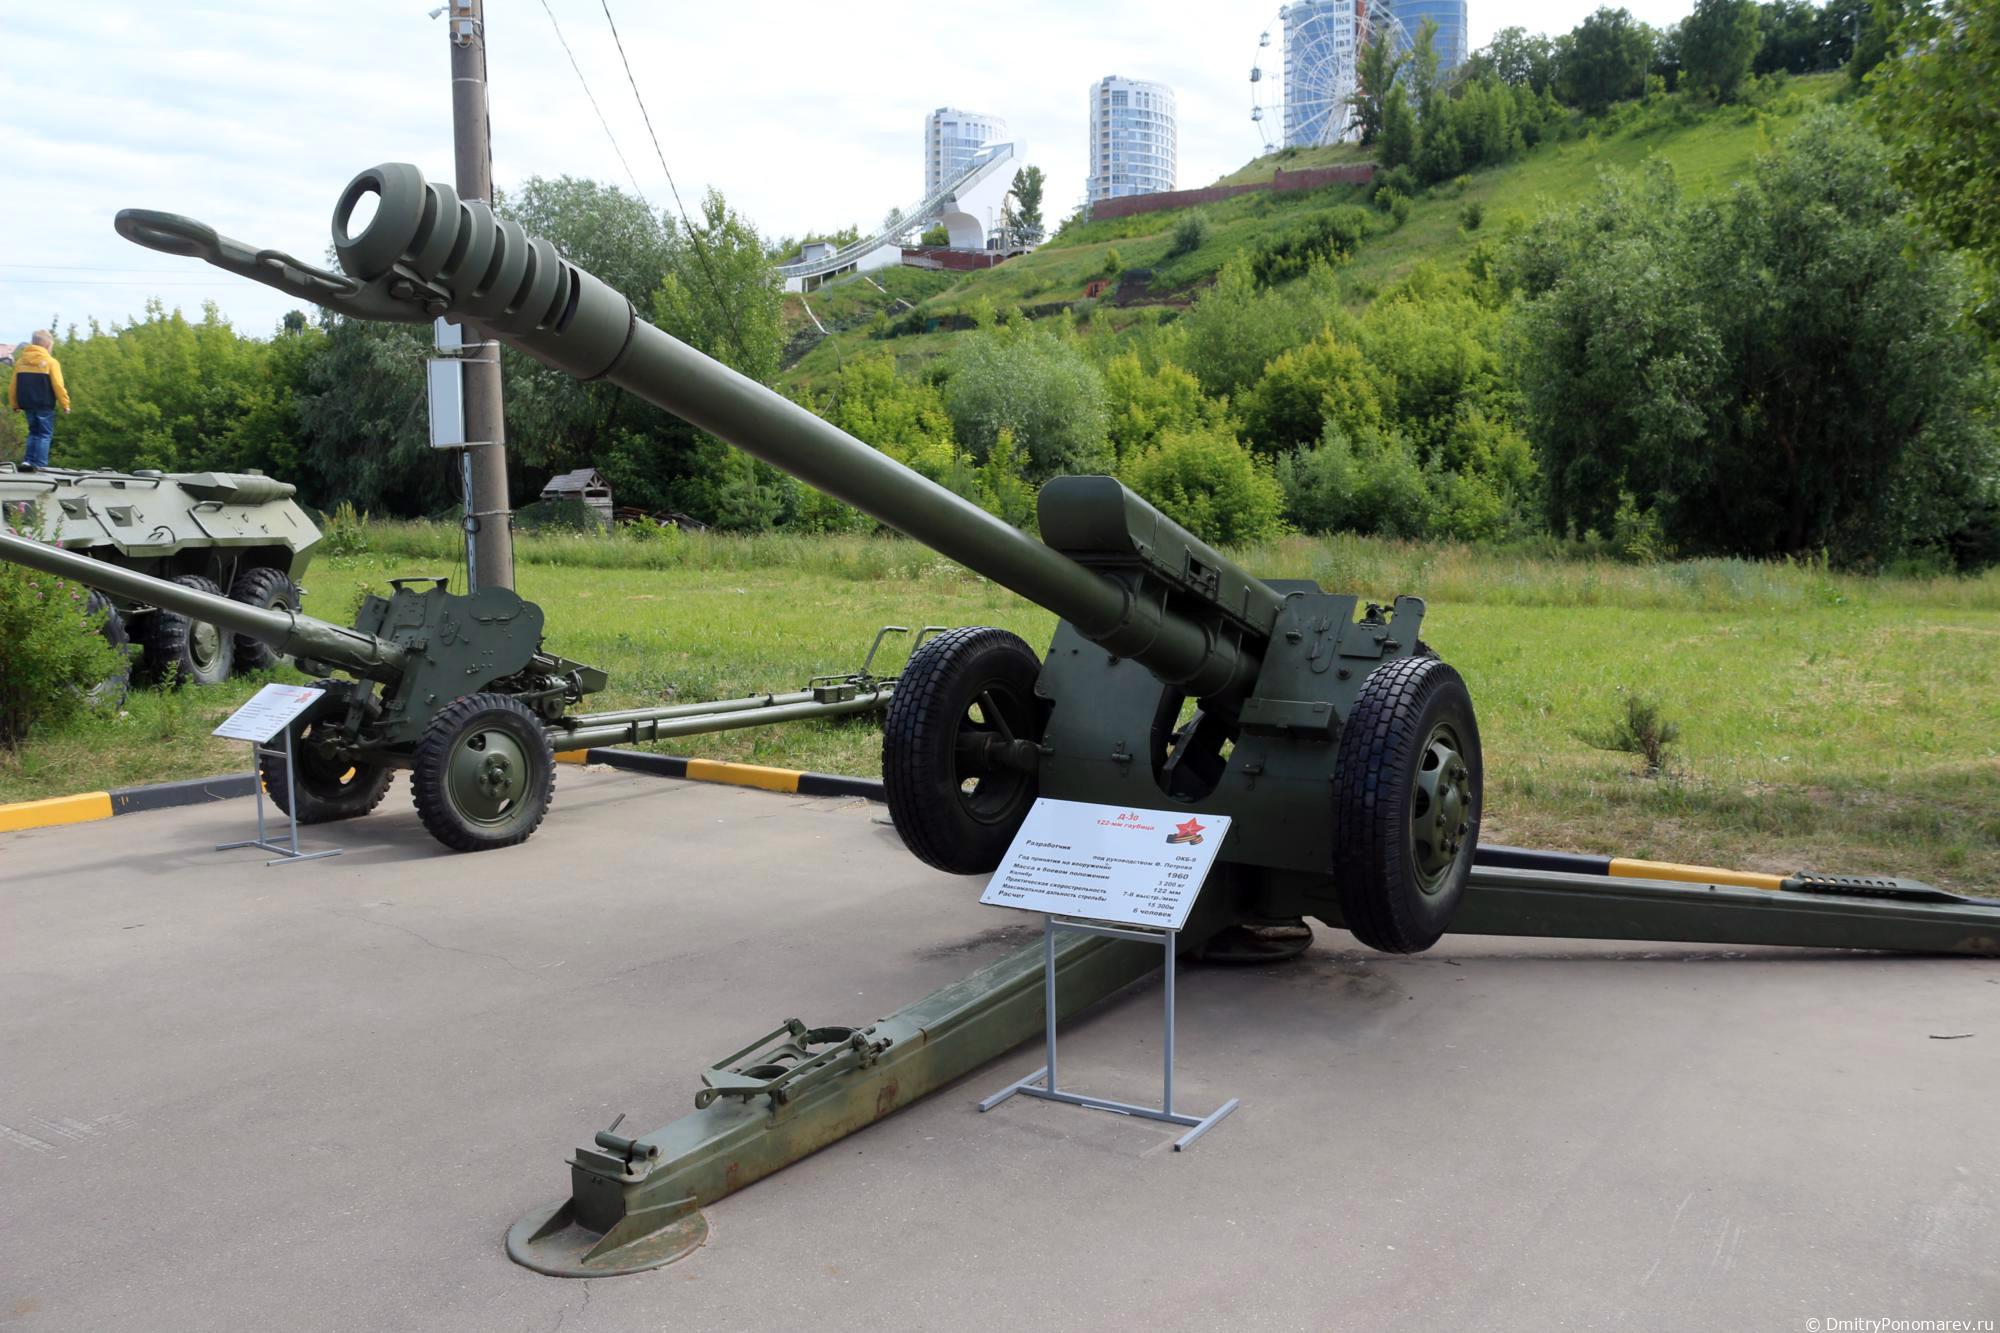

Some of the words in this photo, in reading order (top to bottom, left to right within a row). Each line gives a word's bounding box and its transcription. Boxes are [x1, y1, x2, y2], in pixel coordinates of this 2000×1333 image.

[1026, 840, 1071, 850] Разработчик
[1106, 857, 1153, 865] руководством
[1070, 870, 1109, 879] положении
[1006, 876, 1048, 886] Практическая
[1050, 882, 1106, 894] скорострельность
[998, 891, 1024, 899] Расчет
[1002, 883, 1044, 893] Максимальная
[1046, 889, 1076, 898] дальность
[1078, 893, 1107, 901] стрельбы
